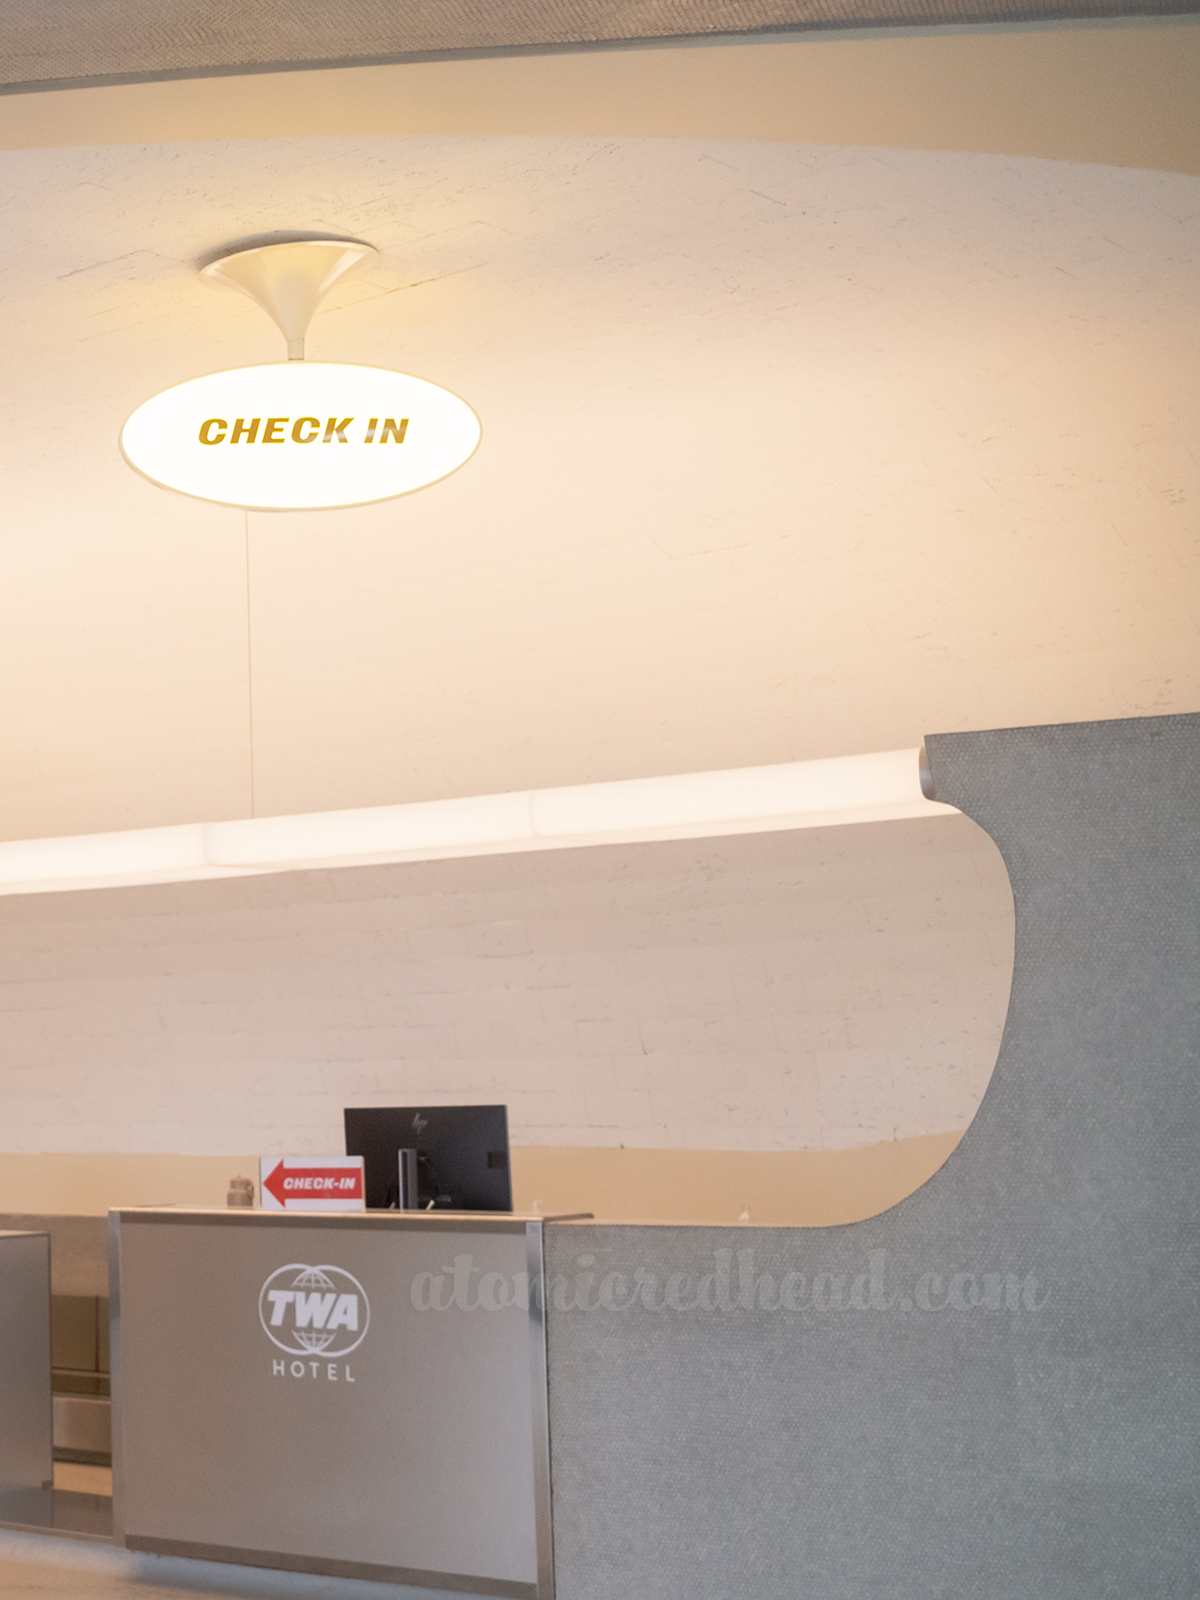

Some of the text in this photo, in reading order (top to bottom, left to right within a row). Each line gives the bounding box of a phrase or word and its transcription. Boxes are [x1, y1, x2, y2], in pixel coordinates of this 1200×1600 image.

[198, 416, 410, 446] CHECK IN
[283, 1177, 355, 1190] CHECK-IN
[267, 1290, 359, 1331] TWA
[273, 1359, 356, 1383] HOTEL
